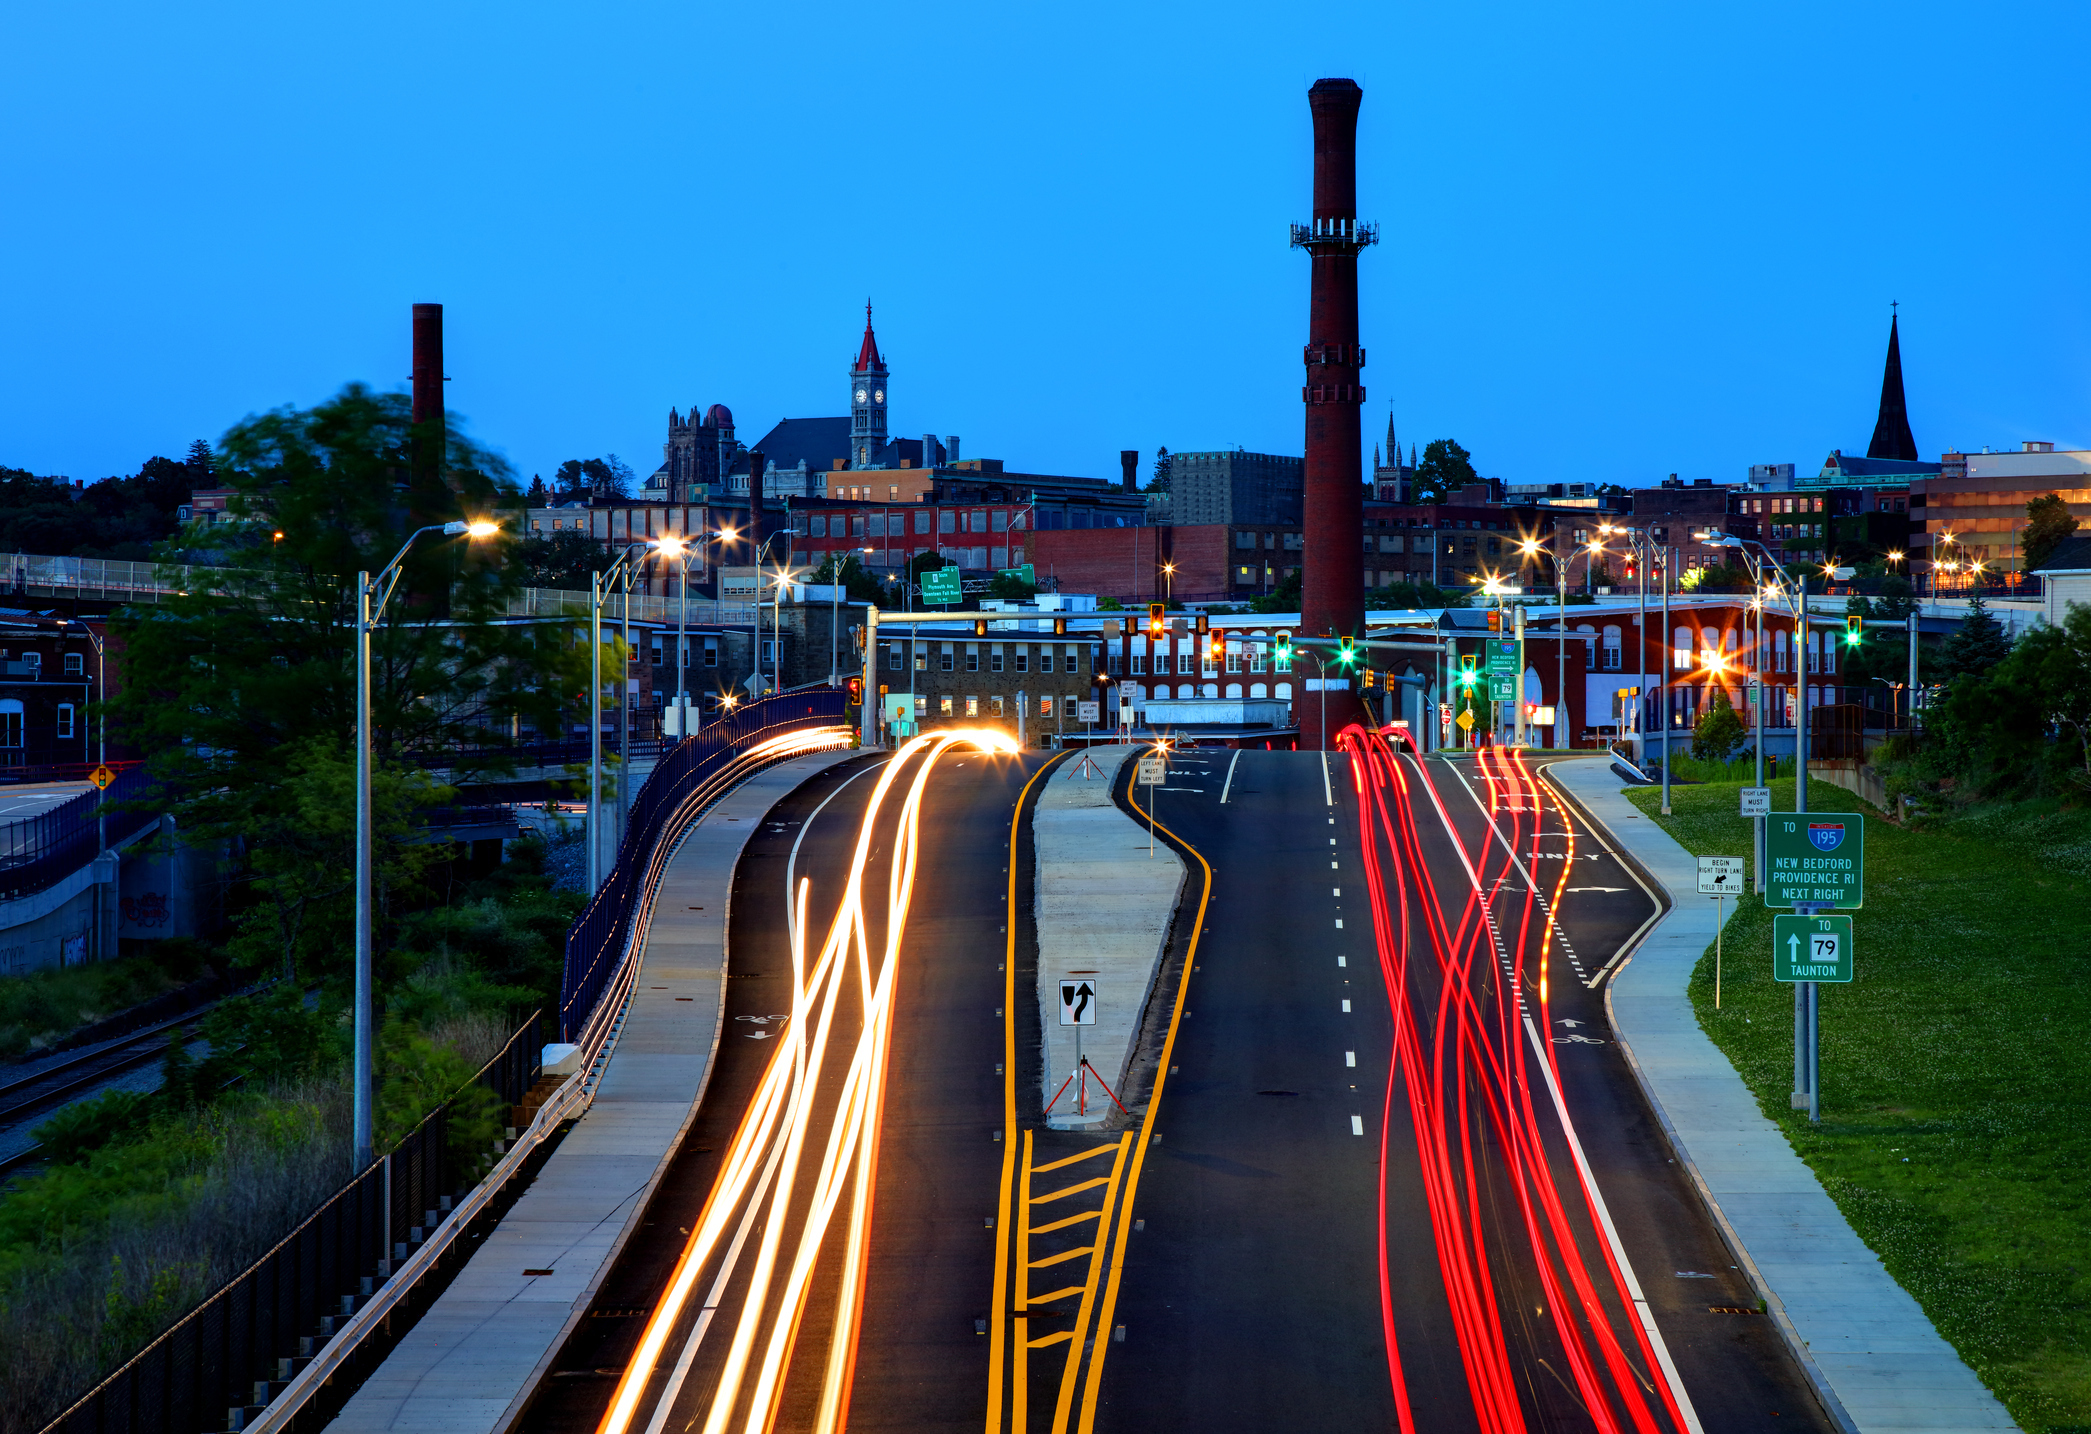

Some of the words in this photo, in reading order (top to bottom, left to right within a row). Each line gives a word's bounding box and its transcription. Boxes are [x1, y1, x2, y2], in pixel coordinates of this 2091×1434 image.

[1783, 822, 1796, 832] TO
[1817, 832, 1836, 844] 195
[1526, 853, 1600, 861] ONLY
[1776, 858, 1798, 868] NEW
[1804, 858, 1852, 869] BEDFORD
[1774, 872, 1838, 883] PROVIDENCE
[1844, 874, 1854, 884] RI
[1783, 888, 1809, 899] NEXT
[1814, 889, 1844, 900] RIGHT
[1819, 920, 1831, 931] TO
[1814, 940, 1835, 955] 79
[1791, 965, 1836, 976] TAUNTON
